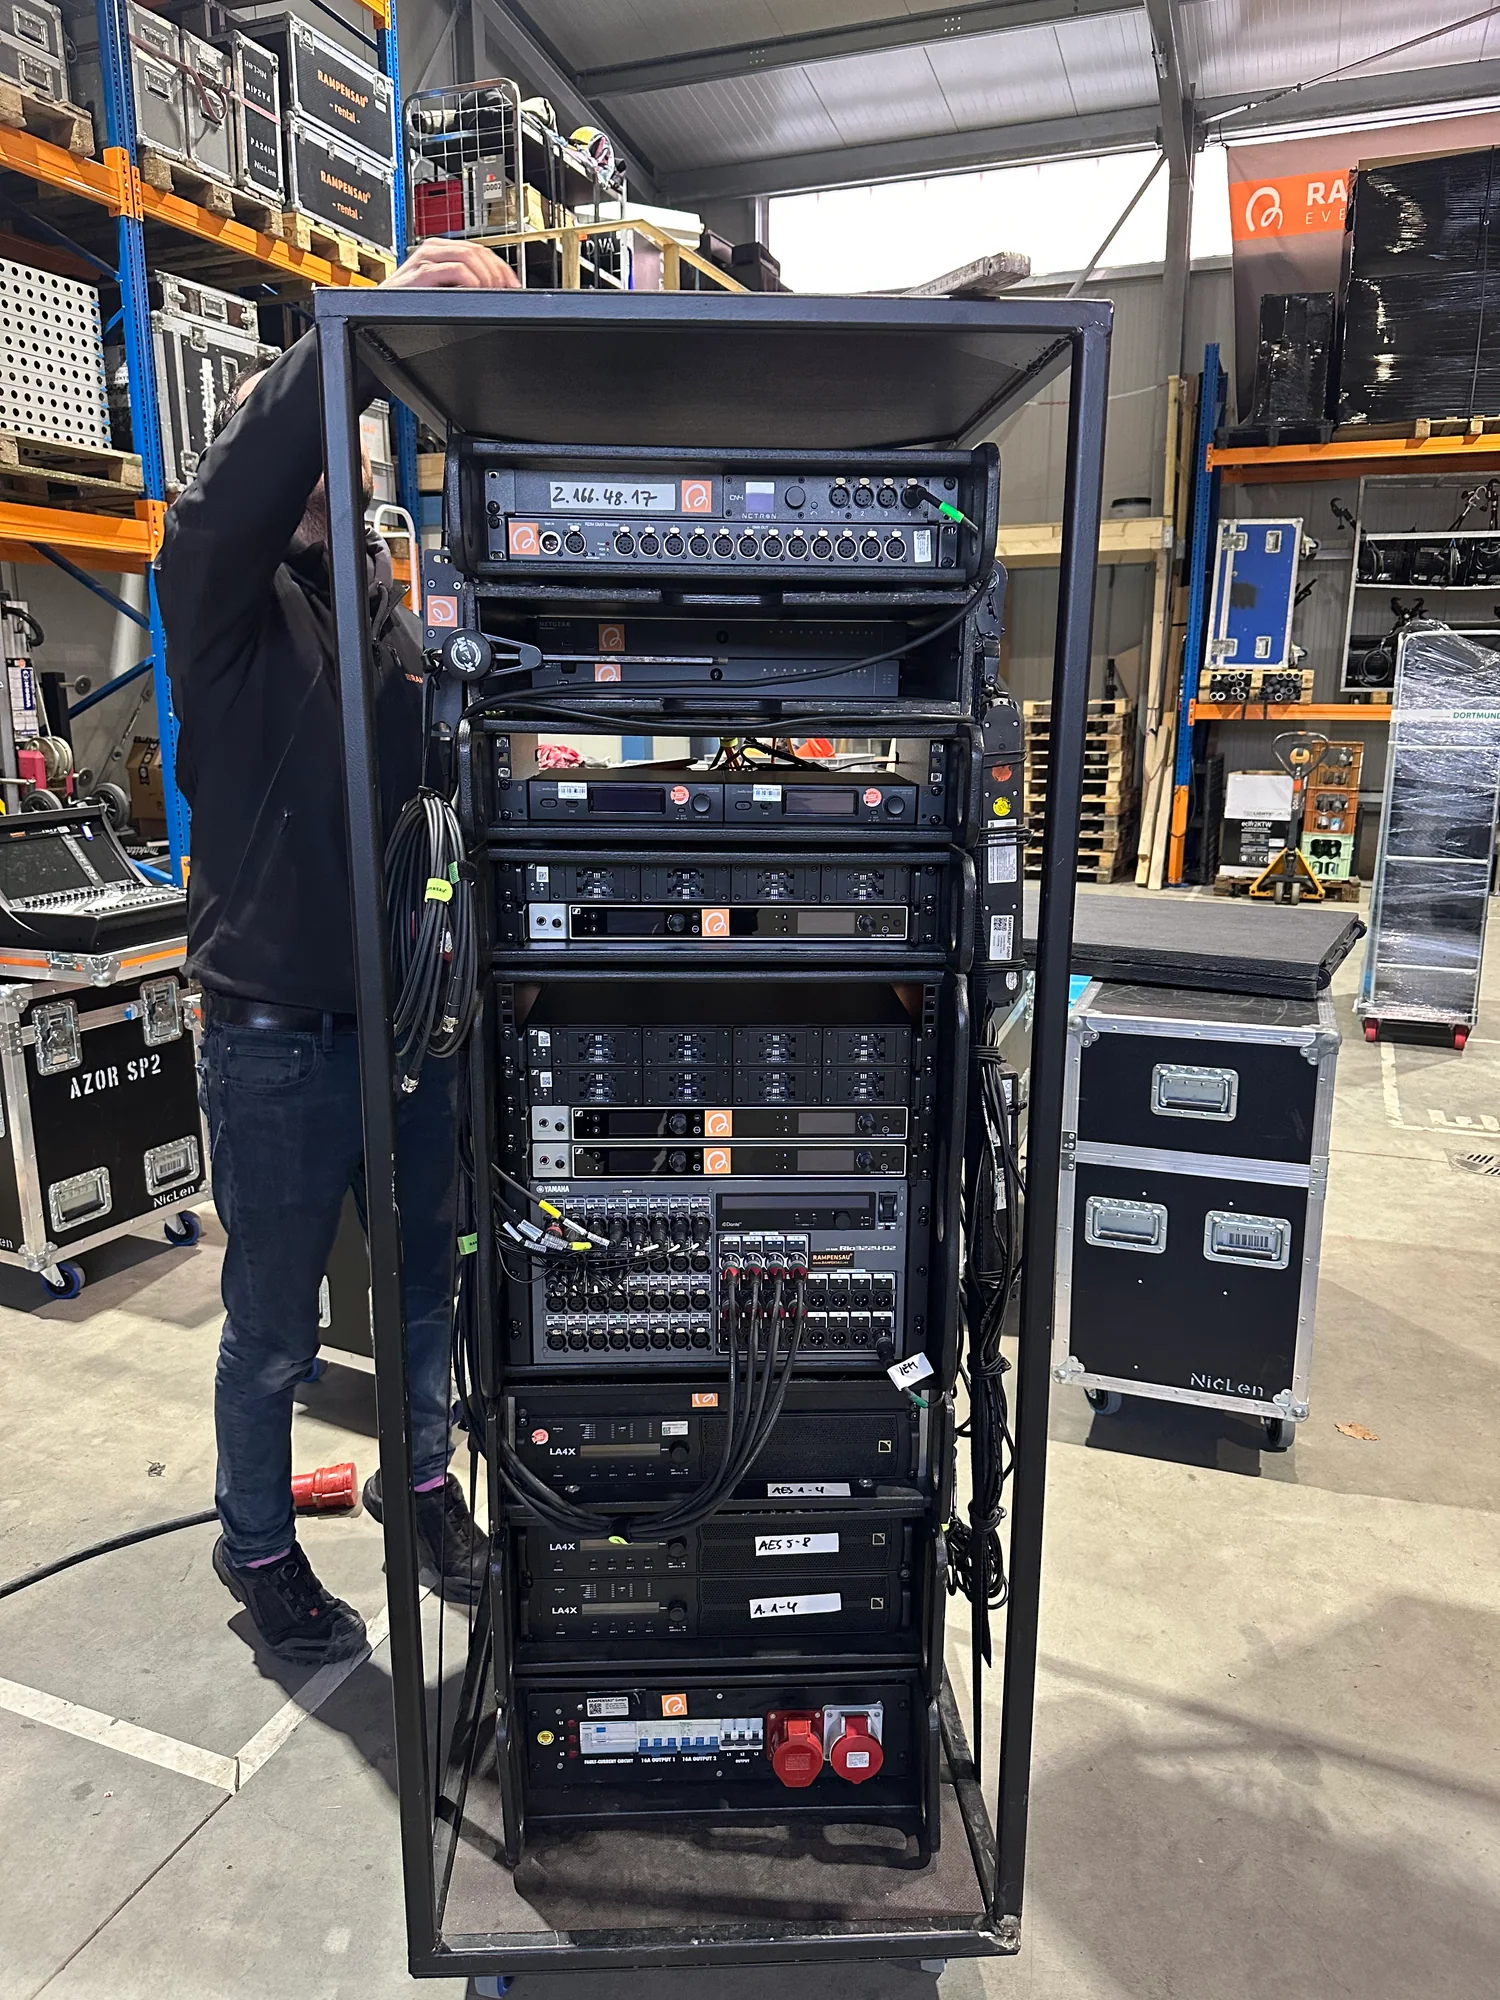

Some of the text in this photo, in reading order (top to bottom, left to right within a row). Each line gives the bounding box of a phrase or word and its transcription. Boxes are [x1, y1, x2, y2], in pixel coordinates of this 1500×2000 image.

[334, 103, 357, 124] rental
[336, 202, 359, 221] rental
[69, 1053, 162, 1100] AZOR SP2
[153, 1183, 196, 1209] NicLen
[544, 1185, 570, 1193] YAMAHA
[1190, 1372, 1265, 1398] NicLen
[549, 1447, 577, 1456] LA4X
[549, 1543, 576, 1551] LA4X
[758, 1539, 782, 1551] AES
[551, 1606, 578, 1614] LA4X
